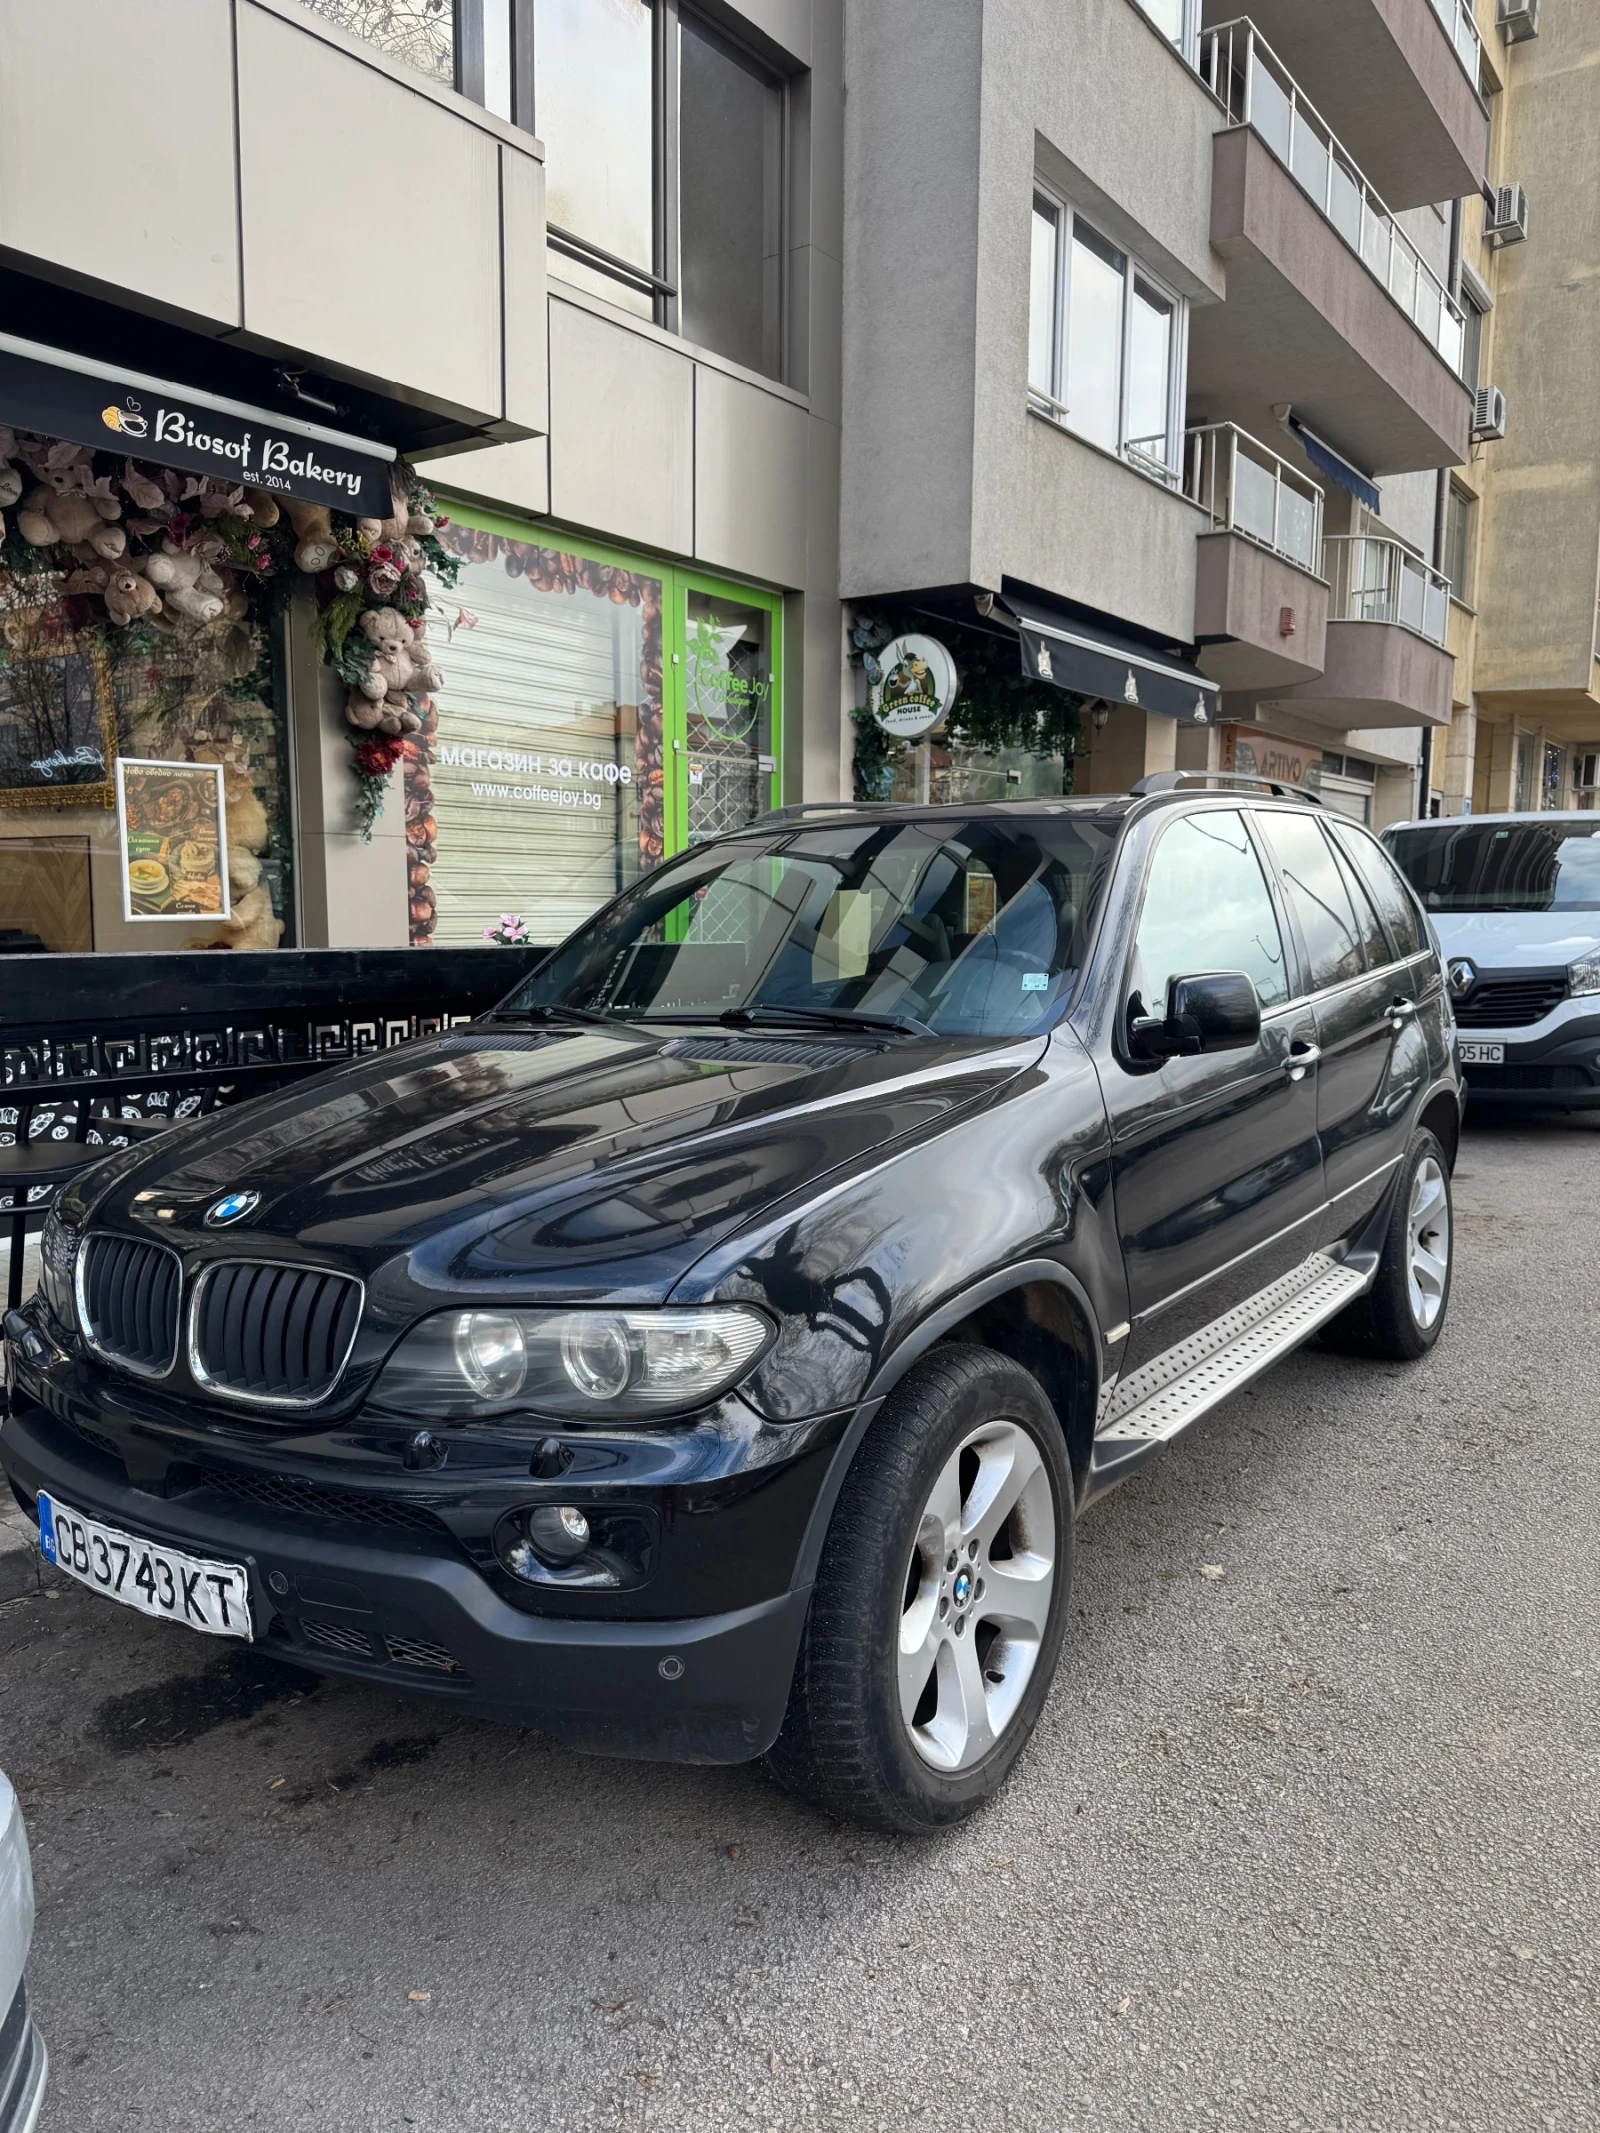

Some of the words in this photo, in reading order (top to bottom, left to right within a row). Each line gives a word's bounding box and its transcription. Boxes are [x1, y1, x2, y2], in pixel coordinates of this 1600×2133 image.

[155, 409, 251, 467] Biosof
[261, 439, 362, 496] Bakery
[243, 470, 263, 485] est.
[266, 474, 292, 491] 2014
[882, 696, 908, 713] Green
[910, 694, 936, 708] coffee
[897, 706, 921, 715] HOUSE
[548, 758, 572, 778] за
[579, 761, 632, 786] кафе
[471, 782, 602, 810] www.coffeejoy.bg
[1479, 1046, 1501, 1061] HC
[44, 1534, 56, 1554] BG
